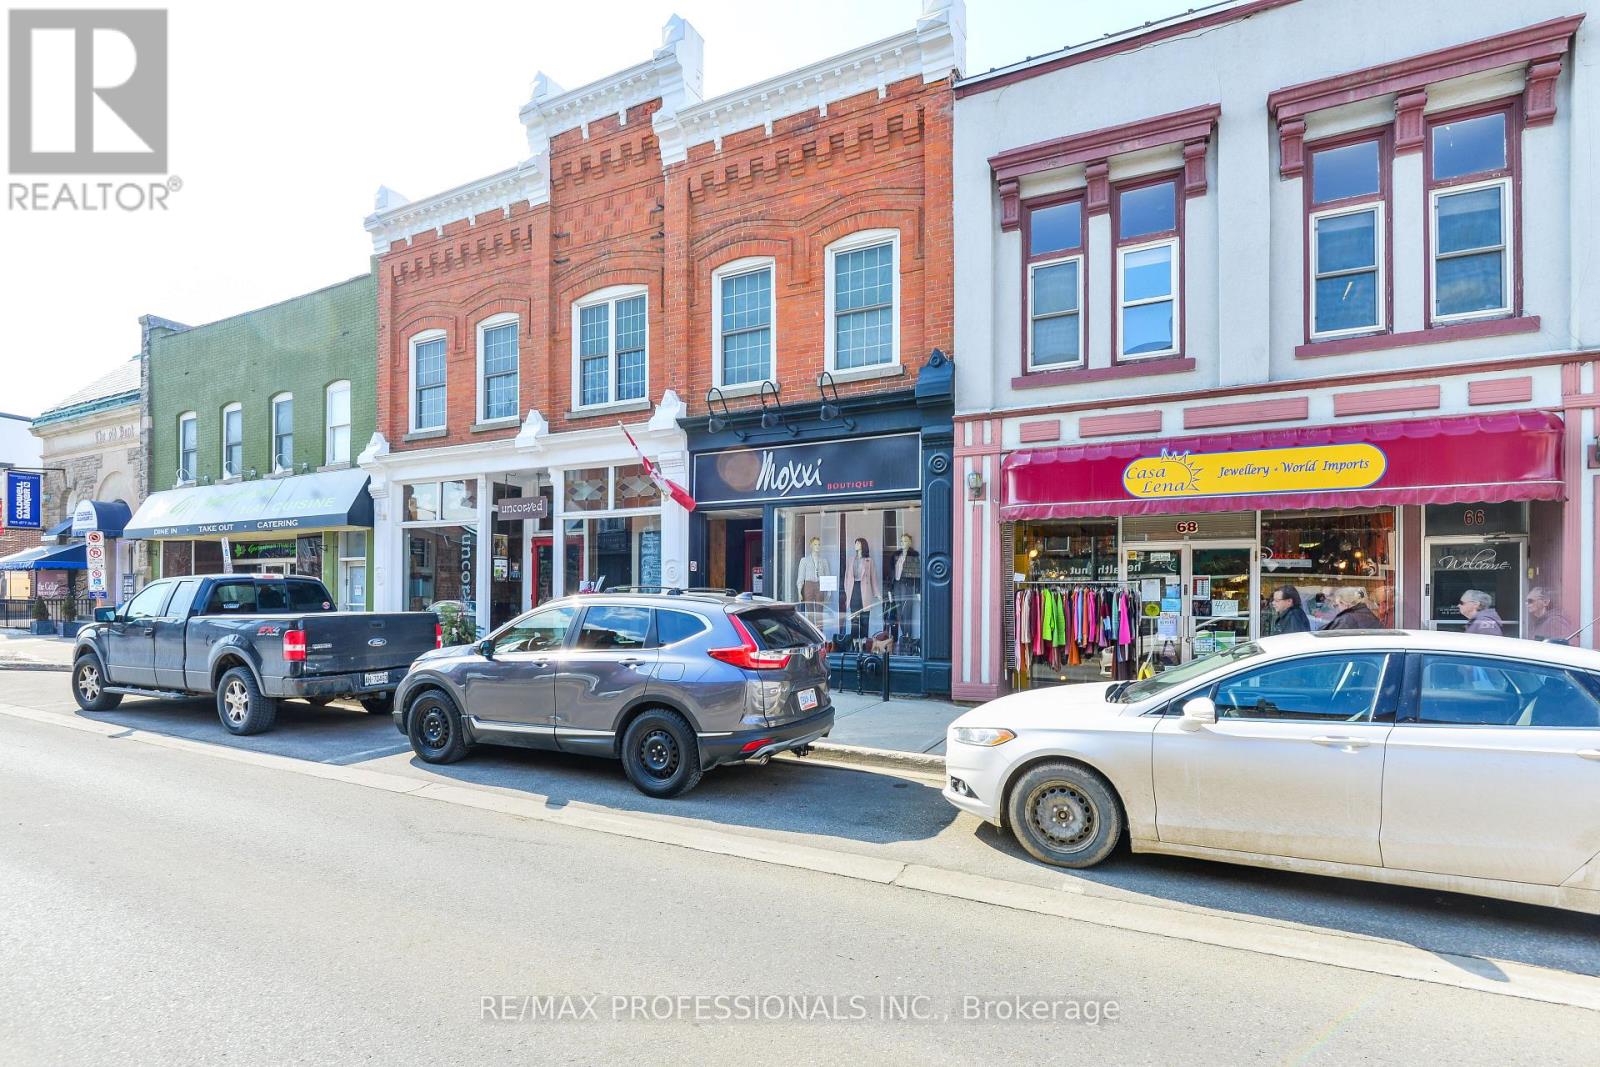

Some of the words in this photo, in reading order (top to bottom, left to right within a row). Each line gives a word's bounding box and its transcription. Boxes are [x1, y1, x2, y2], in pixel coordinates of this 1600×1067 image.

[756, 450, 822, 496] Moxxi
[827, 480, 875, 490] BOUTIQUE
[1126, 467, 1166, 480] Casa
[1217, 464, 1270, 478] Jewellery
[1280, 460, 1318, 473] World
[1322, 458, 1370, 472] Imports
[1141, 481, 1185, 493] Lena
[1463, 510, 1485, 525] 66
[170, 527, 178, 535] IN
[198, 525, 217, 533] TAKE
[219, 524, 234, 532] OUT
[257, 519, 299, 529] CATERING
[1176, 520, 1198, 533] 68
